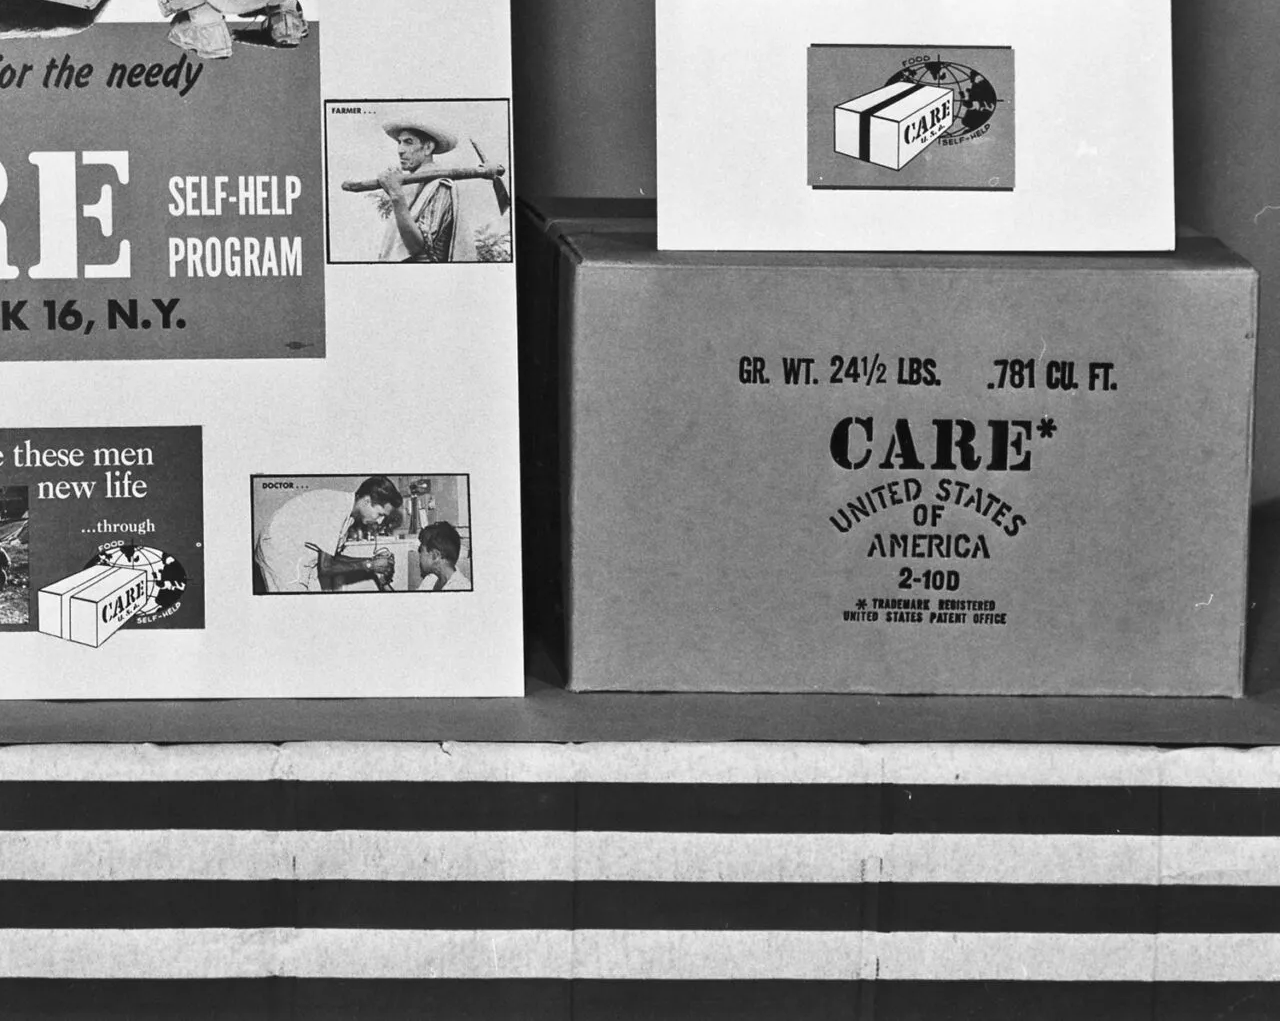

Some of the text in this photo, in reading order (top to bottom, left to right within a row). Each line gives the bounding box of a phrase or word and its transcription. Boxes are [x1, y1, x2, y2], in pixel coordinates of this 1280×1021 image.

[902, 55, 931, 67] FOOD
[43, 52, 94, 89] the
[106, 53, 205, 98] needy
[904, 100, 950, 145] CARE
[942, 124, 991, 146] SELF-HELP
[169, 176, 301, 216] SELF-HELP
[169, 237, 302, 277] PROGRAM
[43, 300, 95, 335] 16,
[108, 298, 186, 329] N.Y.
[739, 356, 770, 384] GR.
[782, 357, 818, 384] WT.
[897, 357, 941, 386] LBS.
[987, 358, 1117, 391] .781 CU. FT.
[14, 440, 84, 467] these
[92, 447, 155, 466] men
[38, 471, 147, 499] new life
[828, 477, 1027, 537] UNITED STATES
[913, 504, 945, 527] OF
[81, 518, 156, 535] ...through
[98, 540, 124, 551] FOOD
[867, 534, 990, 558] AMERICA
[102, 580, 144, 623] CARE
[137, 601, 181, 624] SELF-HELP
[872, 597, 996, 610] TRADEMARK REGISTERED
[843, 610, 1007, 625] UNITED STATES PATENT OFFICE
